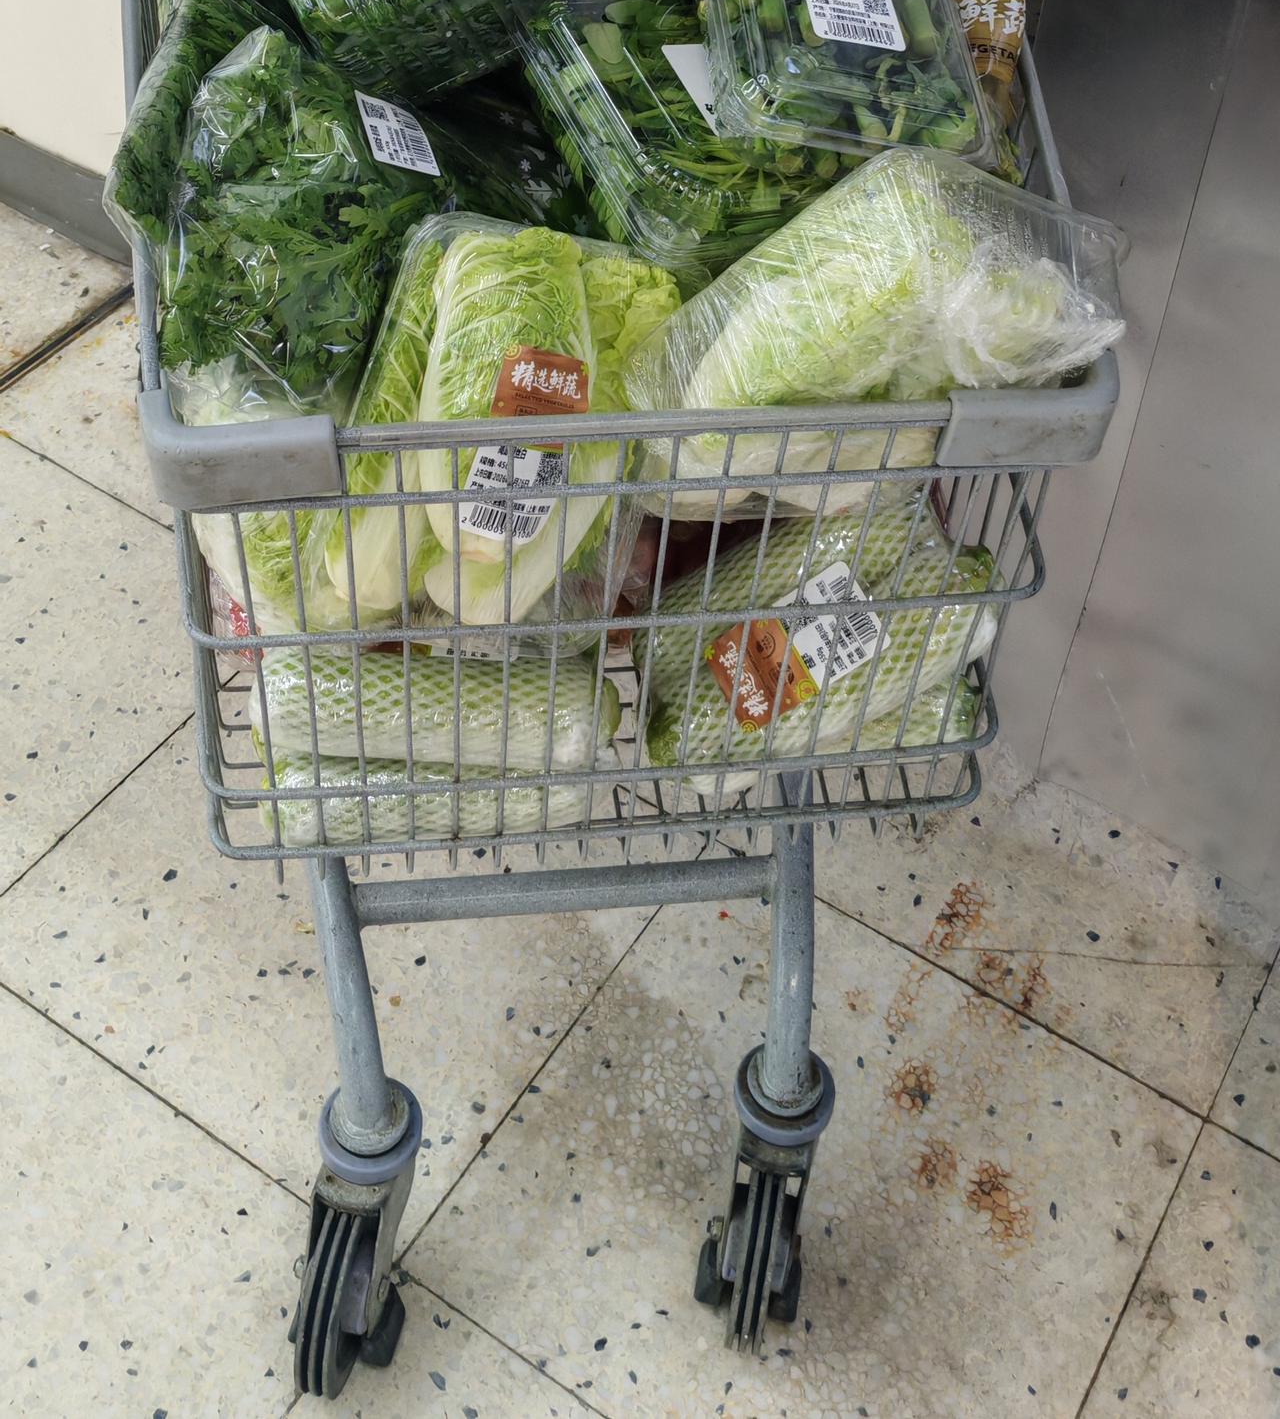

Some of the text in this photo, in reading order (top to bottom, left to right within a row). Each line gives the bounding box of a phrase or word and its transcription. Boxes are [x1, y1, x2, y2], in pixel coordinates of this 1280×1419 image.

[971, 43, 1015, 62] EGETA
[511, 361, 581, 399] 精选鲜蔬
